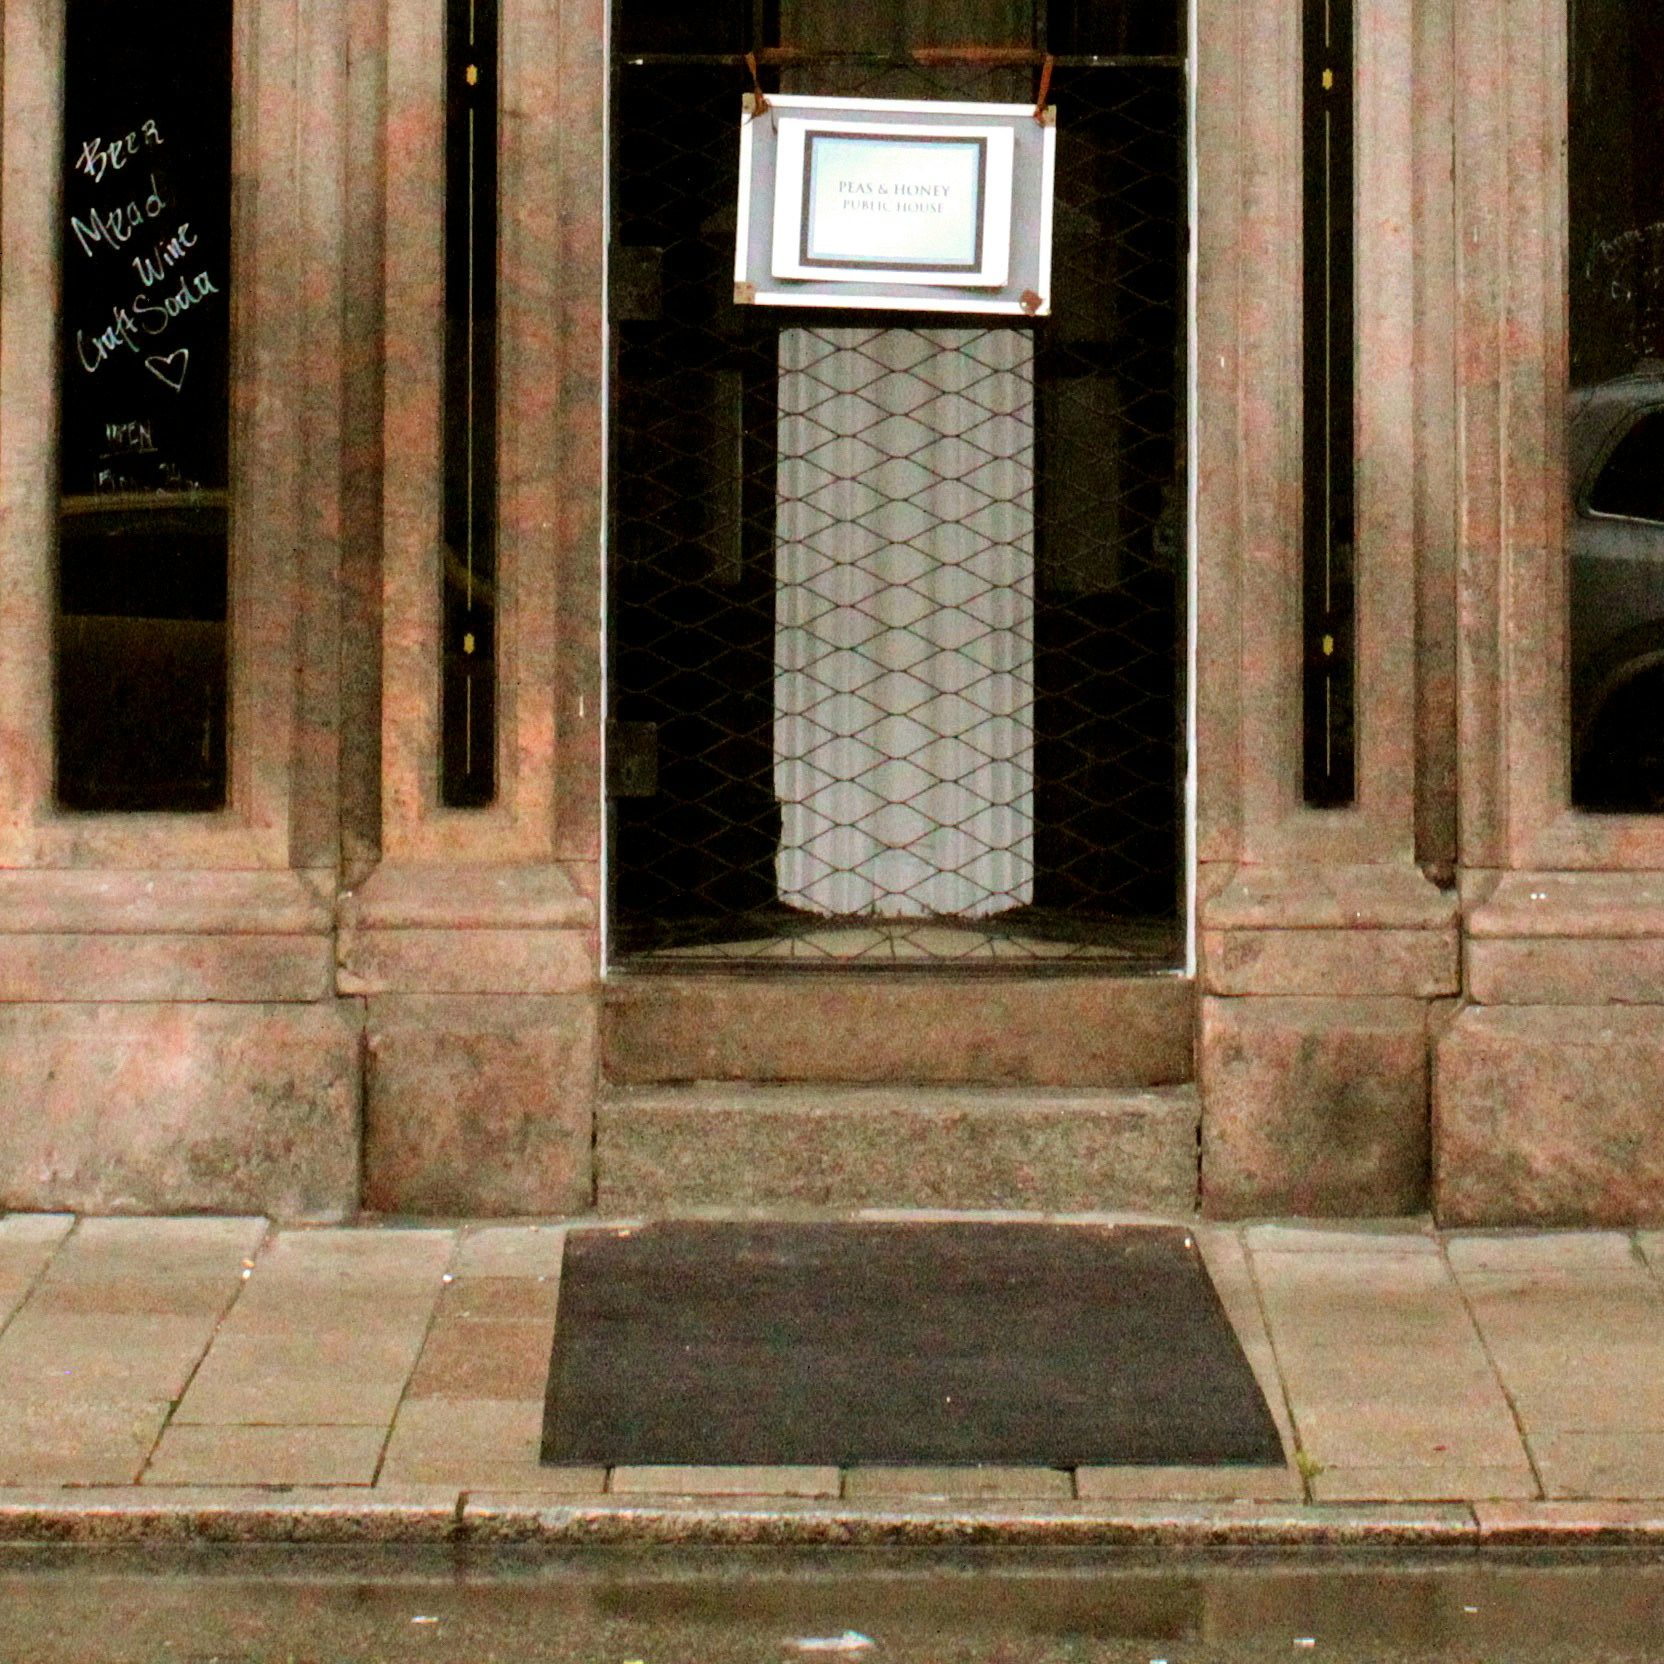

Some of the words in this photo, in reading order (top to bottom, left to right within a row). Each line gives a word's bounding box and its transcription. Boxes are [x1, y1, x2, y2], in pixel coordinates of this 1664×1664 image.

[70, 173, 166, 258] Mead
[839, 180, 874, 195] PEAS
[877, 183, 889, 195] &
[894, 183, 951, 198] HONEY
[843, 198, 893, 212] PUBLIC
[896, 201, 944, 215] HOUSE
[132, 222, 197, 287] Wine
[76, 305, 140, 373] Craft
[132, 271, 219, 335] Soda
